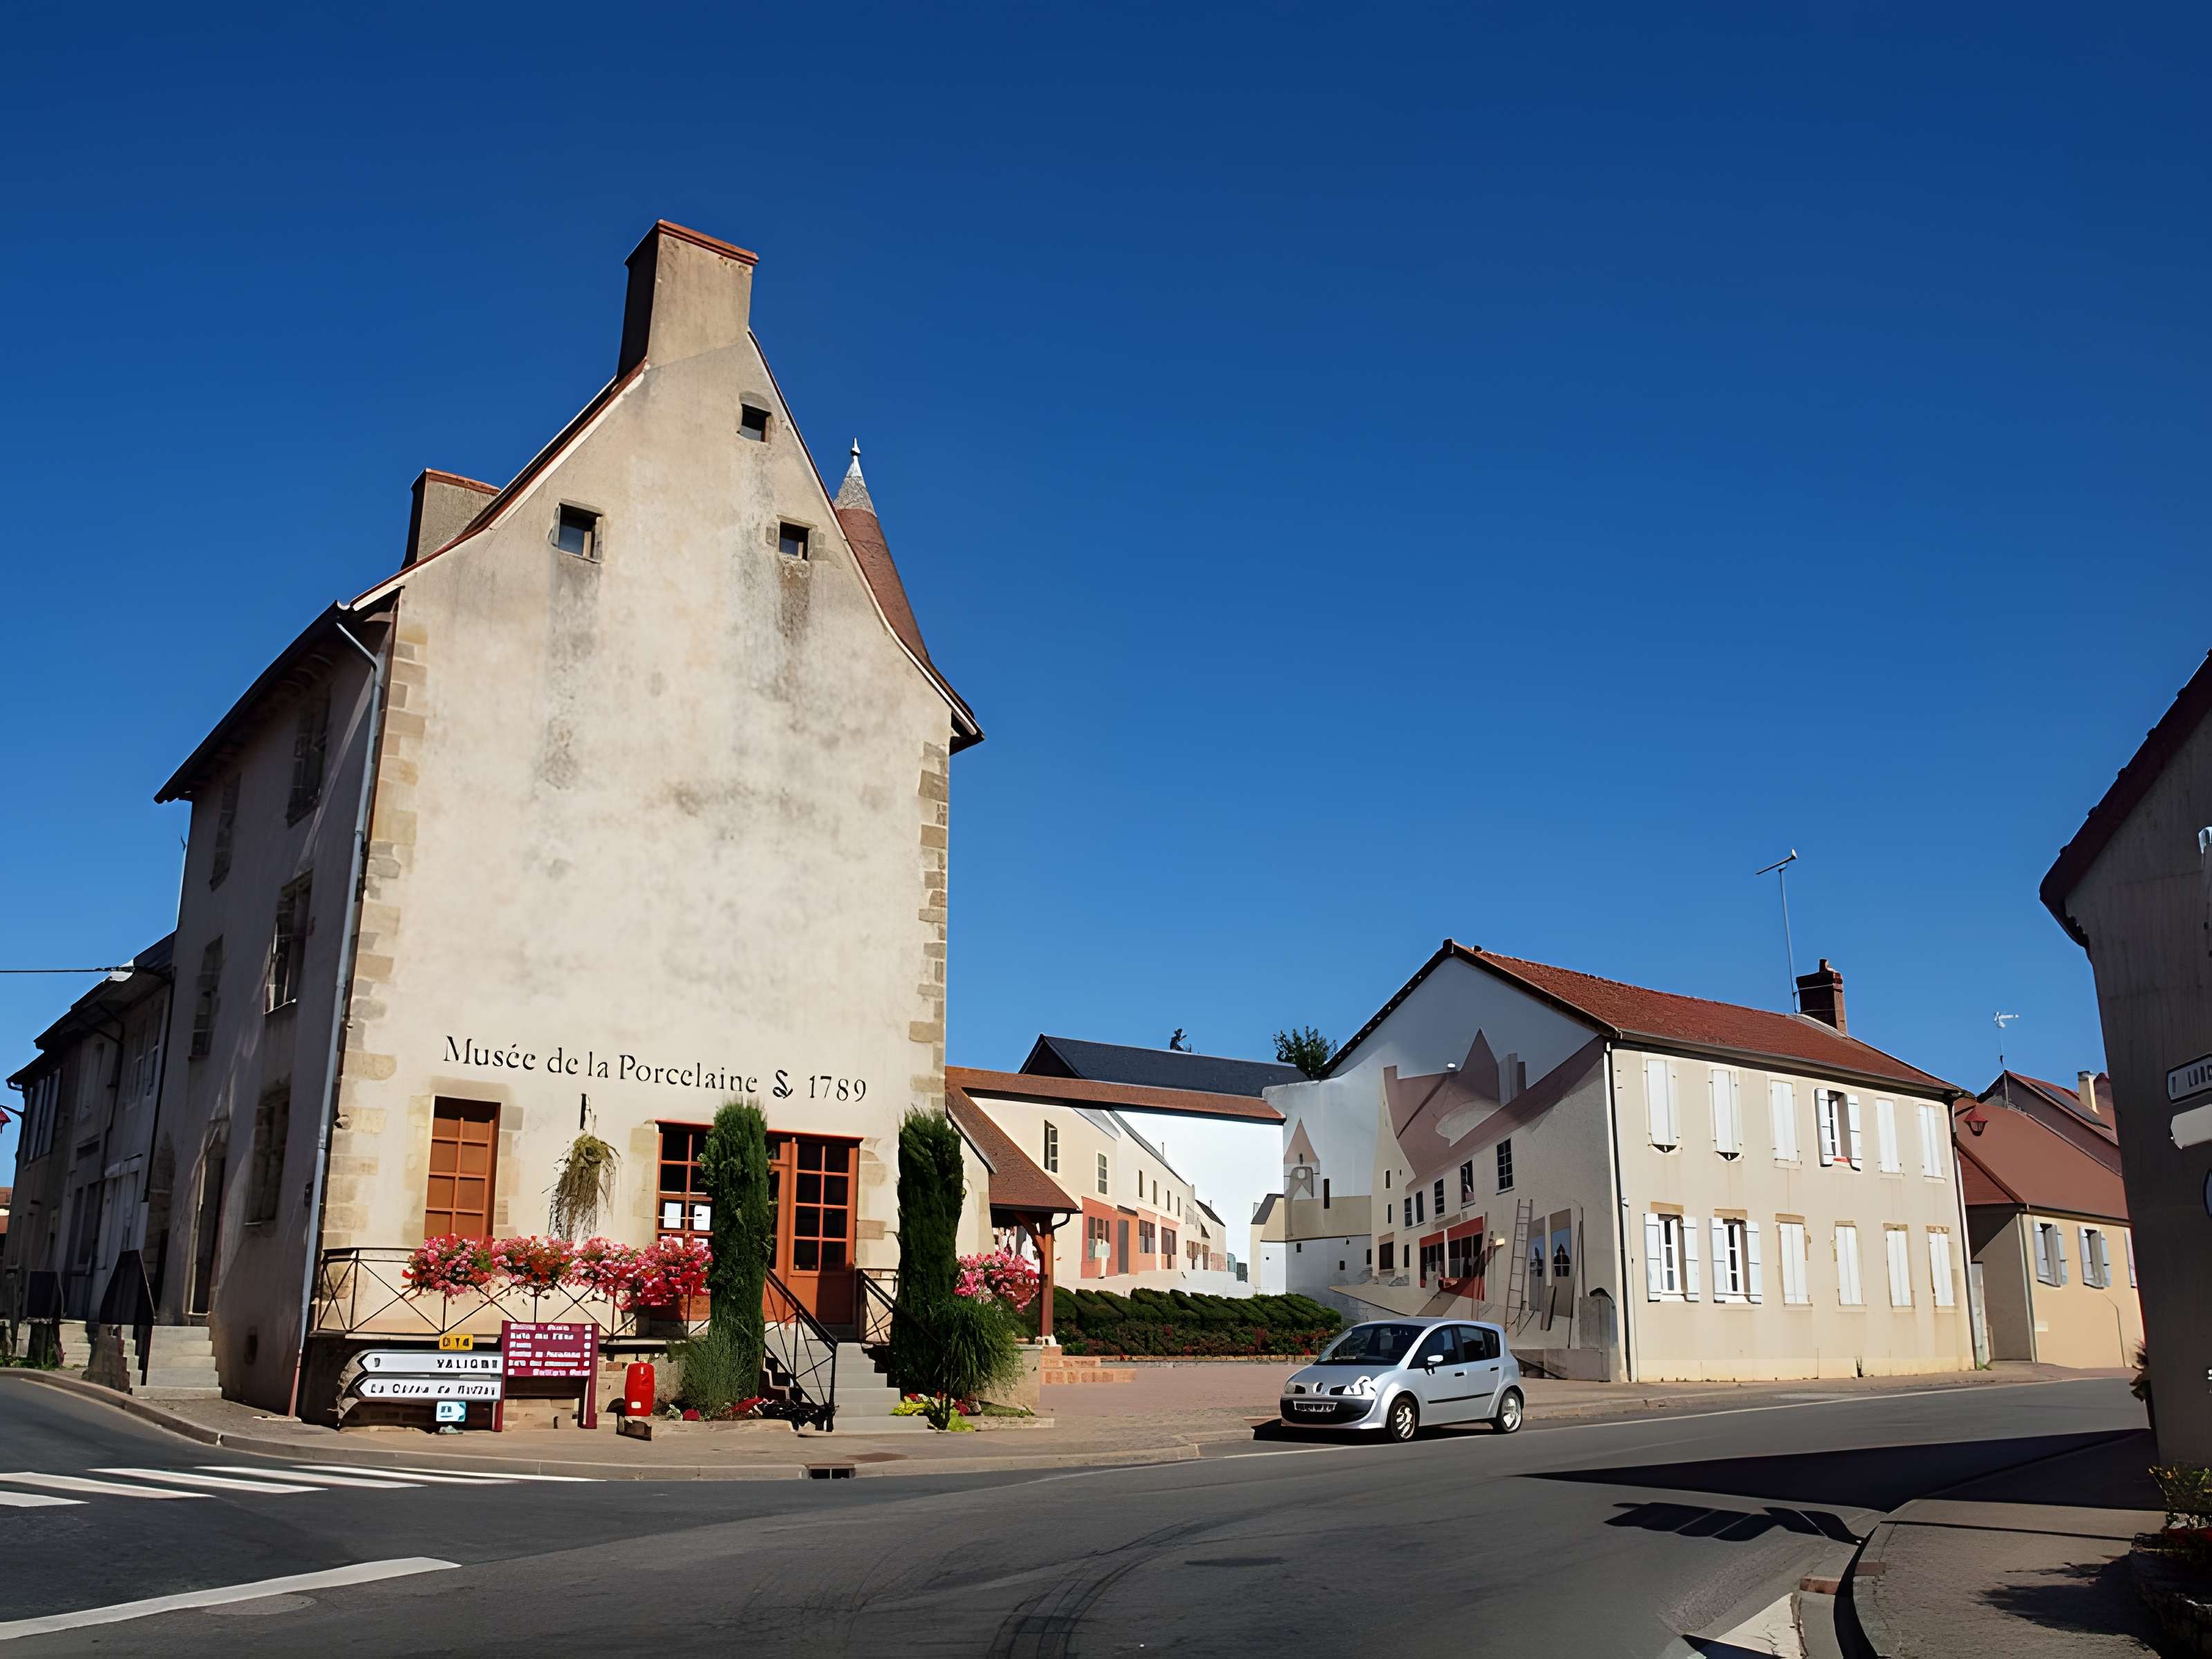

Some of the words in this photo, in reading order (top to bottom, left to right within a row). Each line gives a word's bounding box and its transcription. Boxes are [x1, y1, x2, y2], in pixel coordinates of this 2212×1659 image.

[442, 1035, 536, 1071] Musée
[546, 1047, 579, 1076] de
[587, 1051, 609, 1079] la
[619, 1054, 758, 1094] Porcelaine
[808, 1075, 866, 1103] 1789
